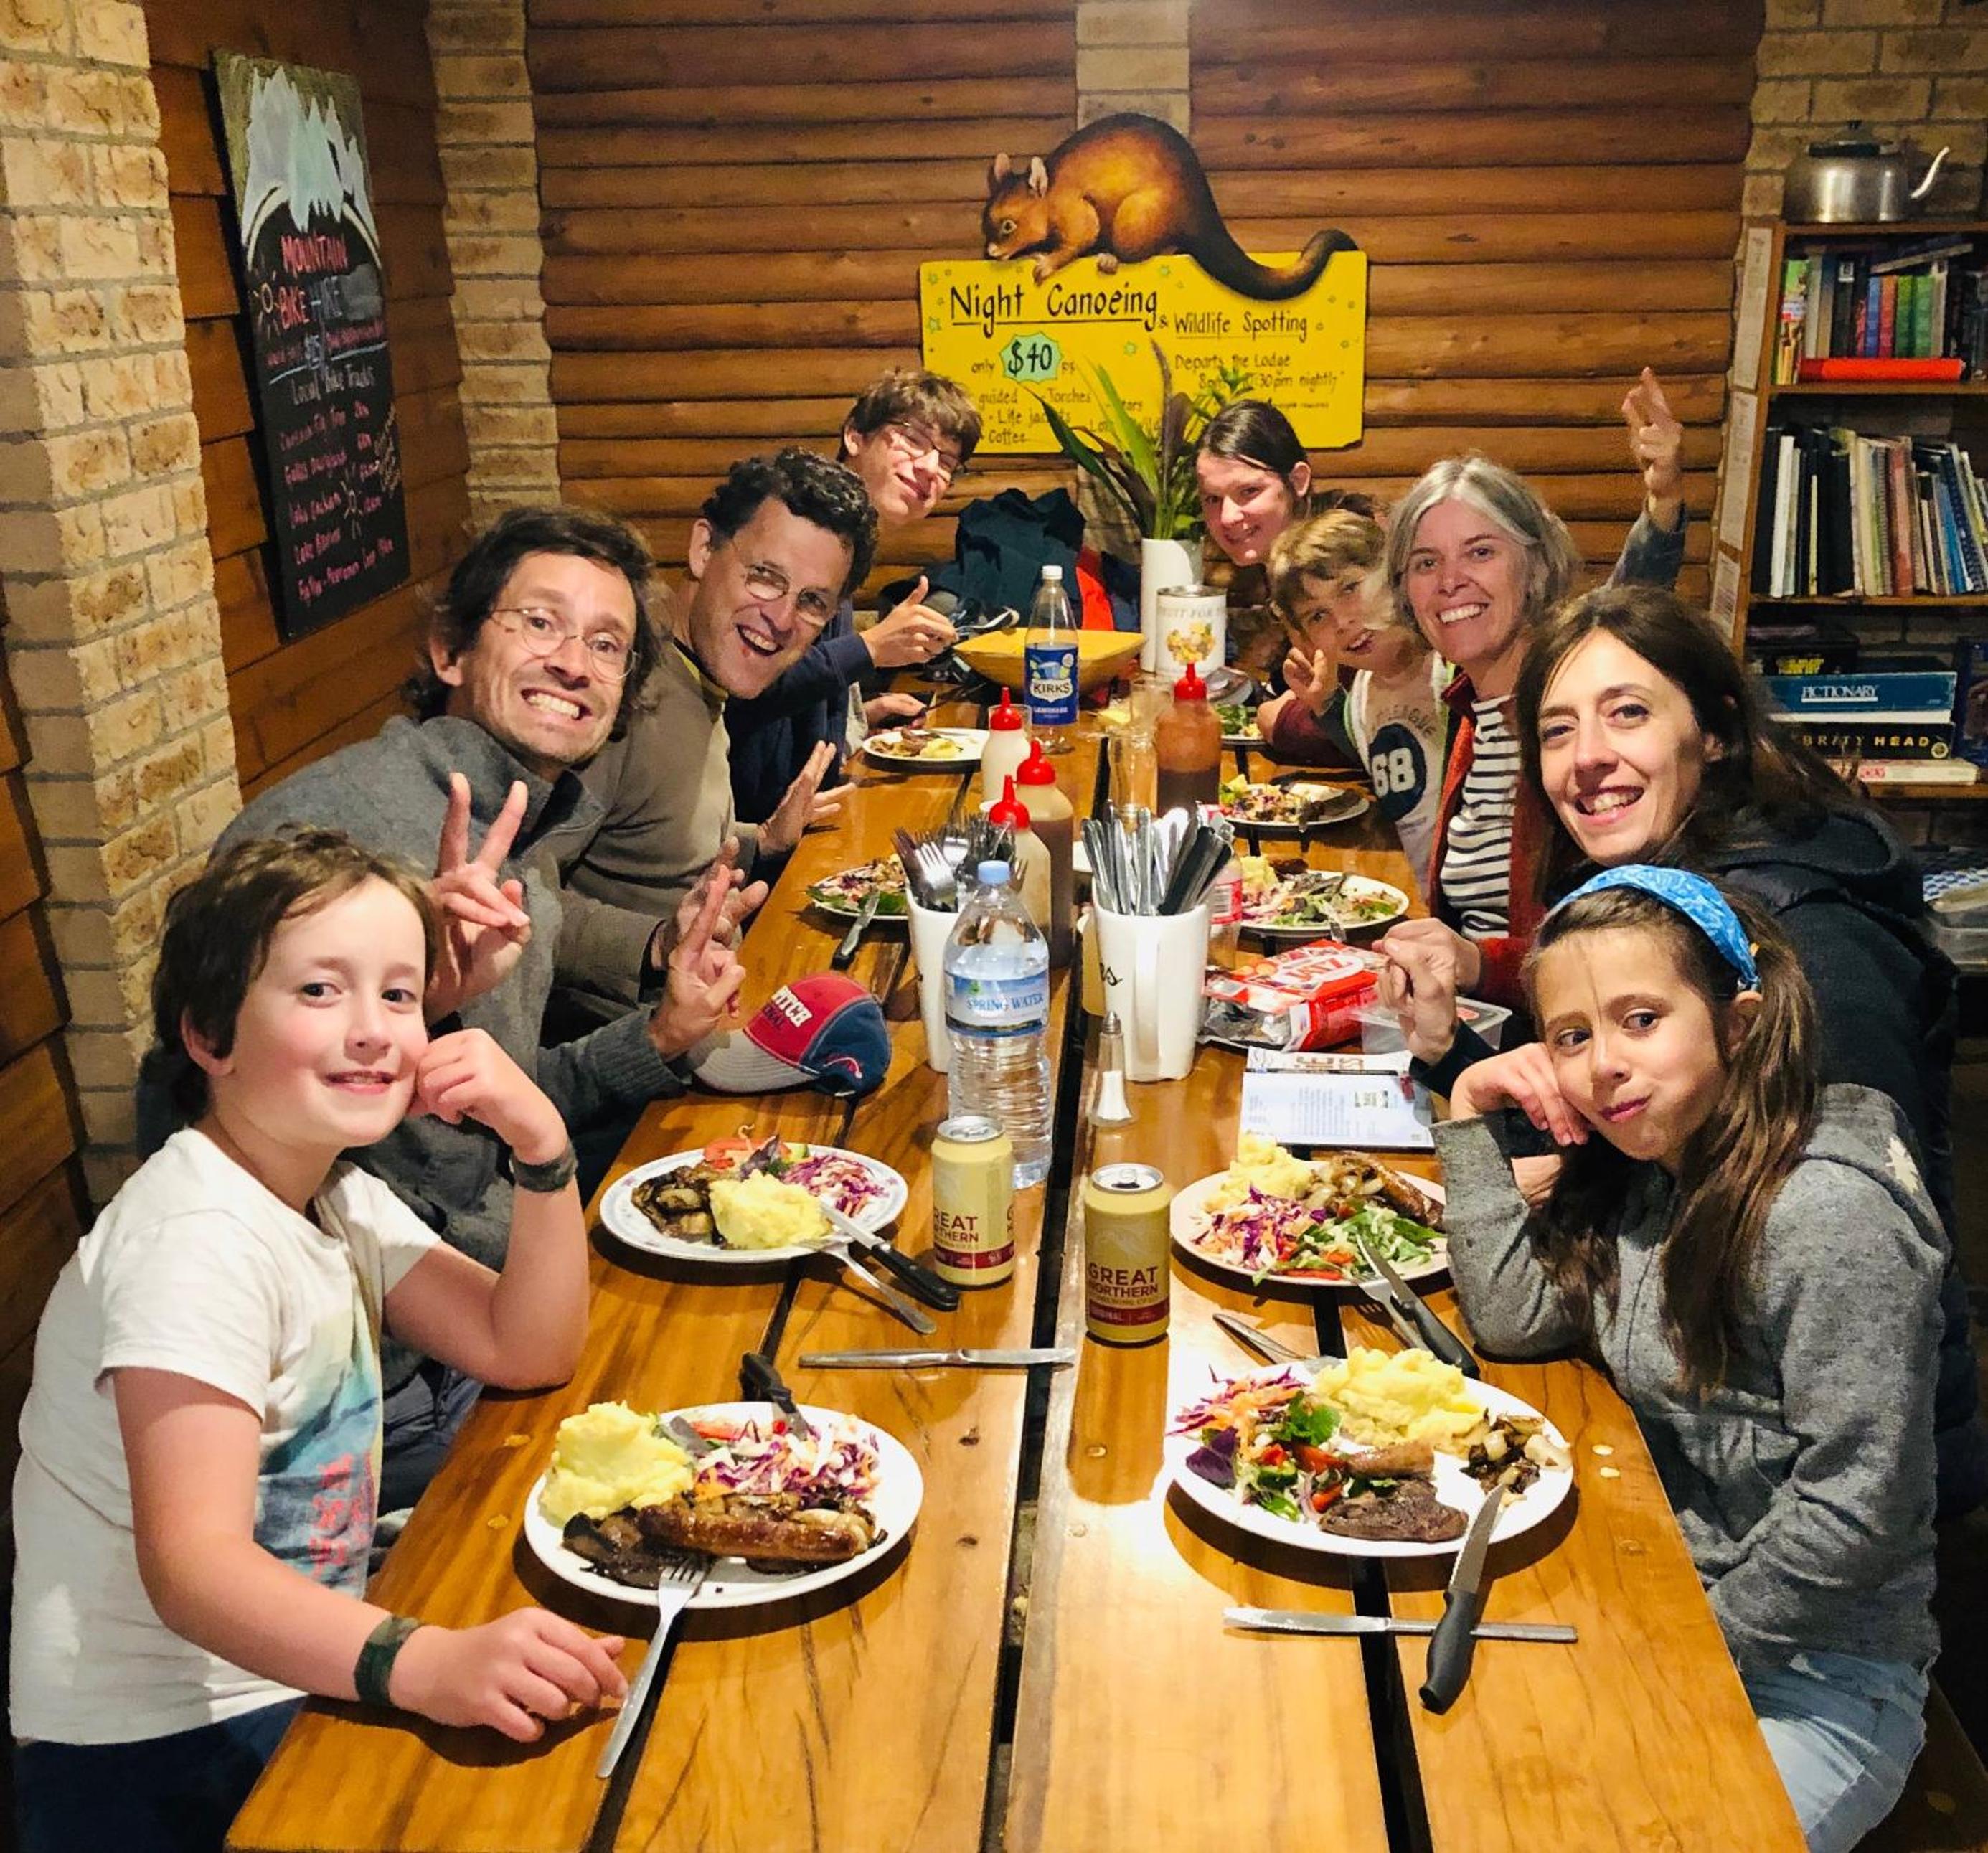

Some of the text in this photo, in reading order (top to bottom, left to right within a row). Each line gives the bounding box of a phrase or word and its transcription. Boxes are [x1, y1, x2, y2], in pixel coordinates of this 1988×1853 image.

[281, 232, 349, 278] MOUNTAIN
[951, 284, 1024, 338] Night
[1047, 282, 1157, 331] Canoeing
[1174, 311, 1230, 337] Wildlife
[1243, 311, 1308, 343] Spotting
[1008, 339, 1053, 376] $40
[1255, 354, 1291, 374] Lodge
[979, 389, 1017, 410] guided
[989, 428, 1026, 445] Coffee
[1034, 683, 1070, 694] KIRKS
[1874, 736, 1930, 746] HEAD
[1372, 747, 1416, 798] 68
[967, 994, 1044, 1012] SPRING WATER
[1089, 1263, 1158, 1286] GREAT
